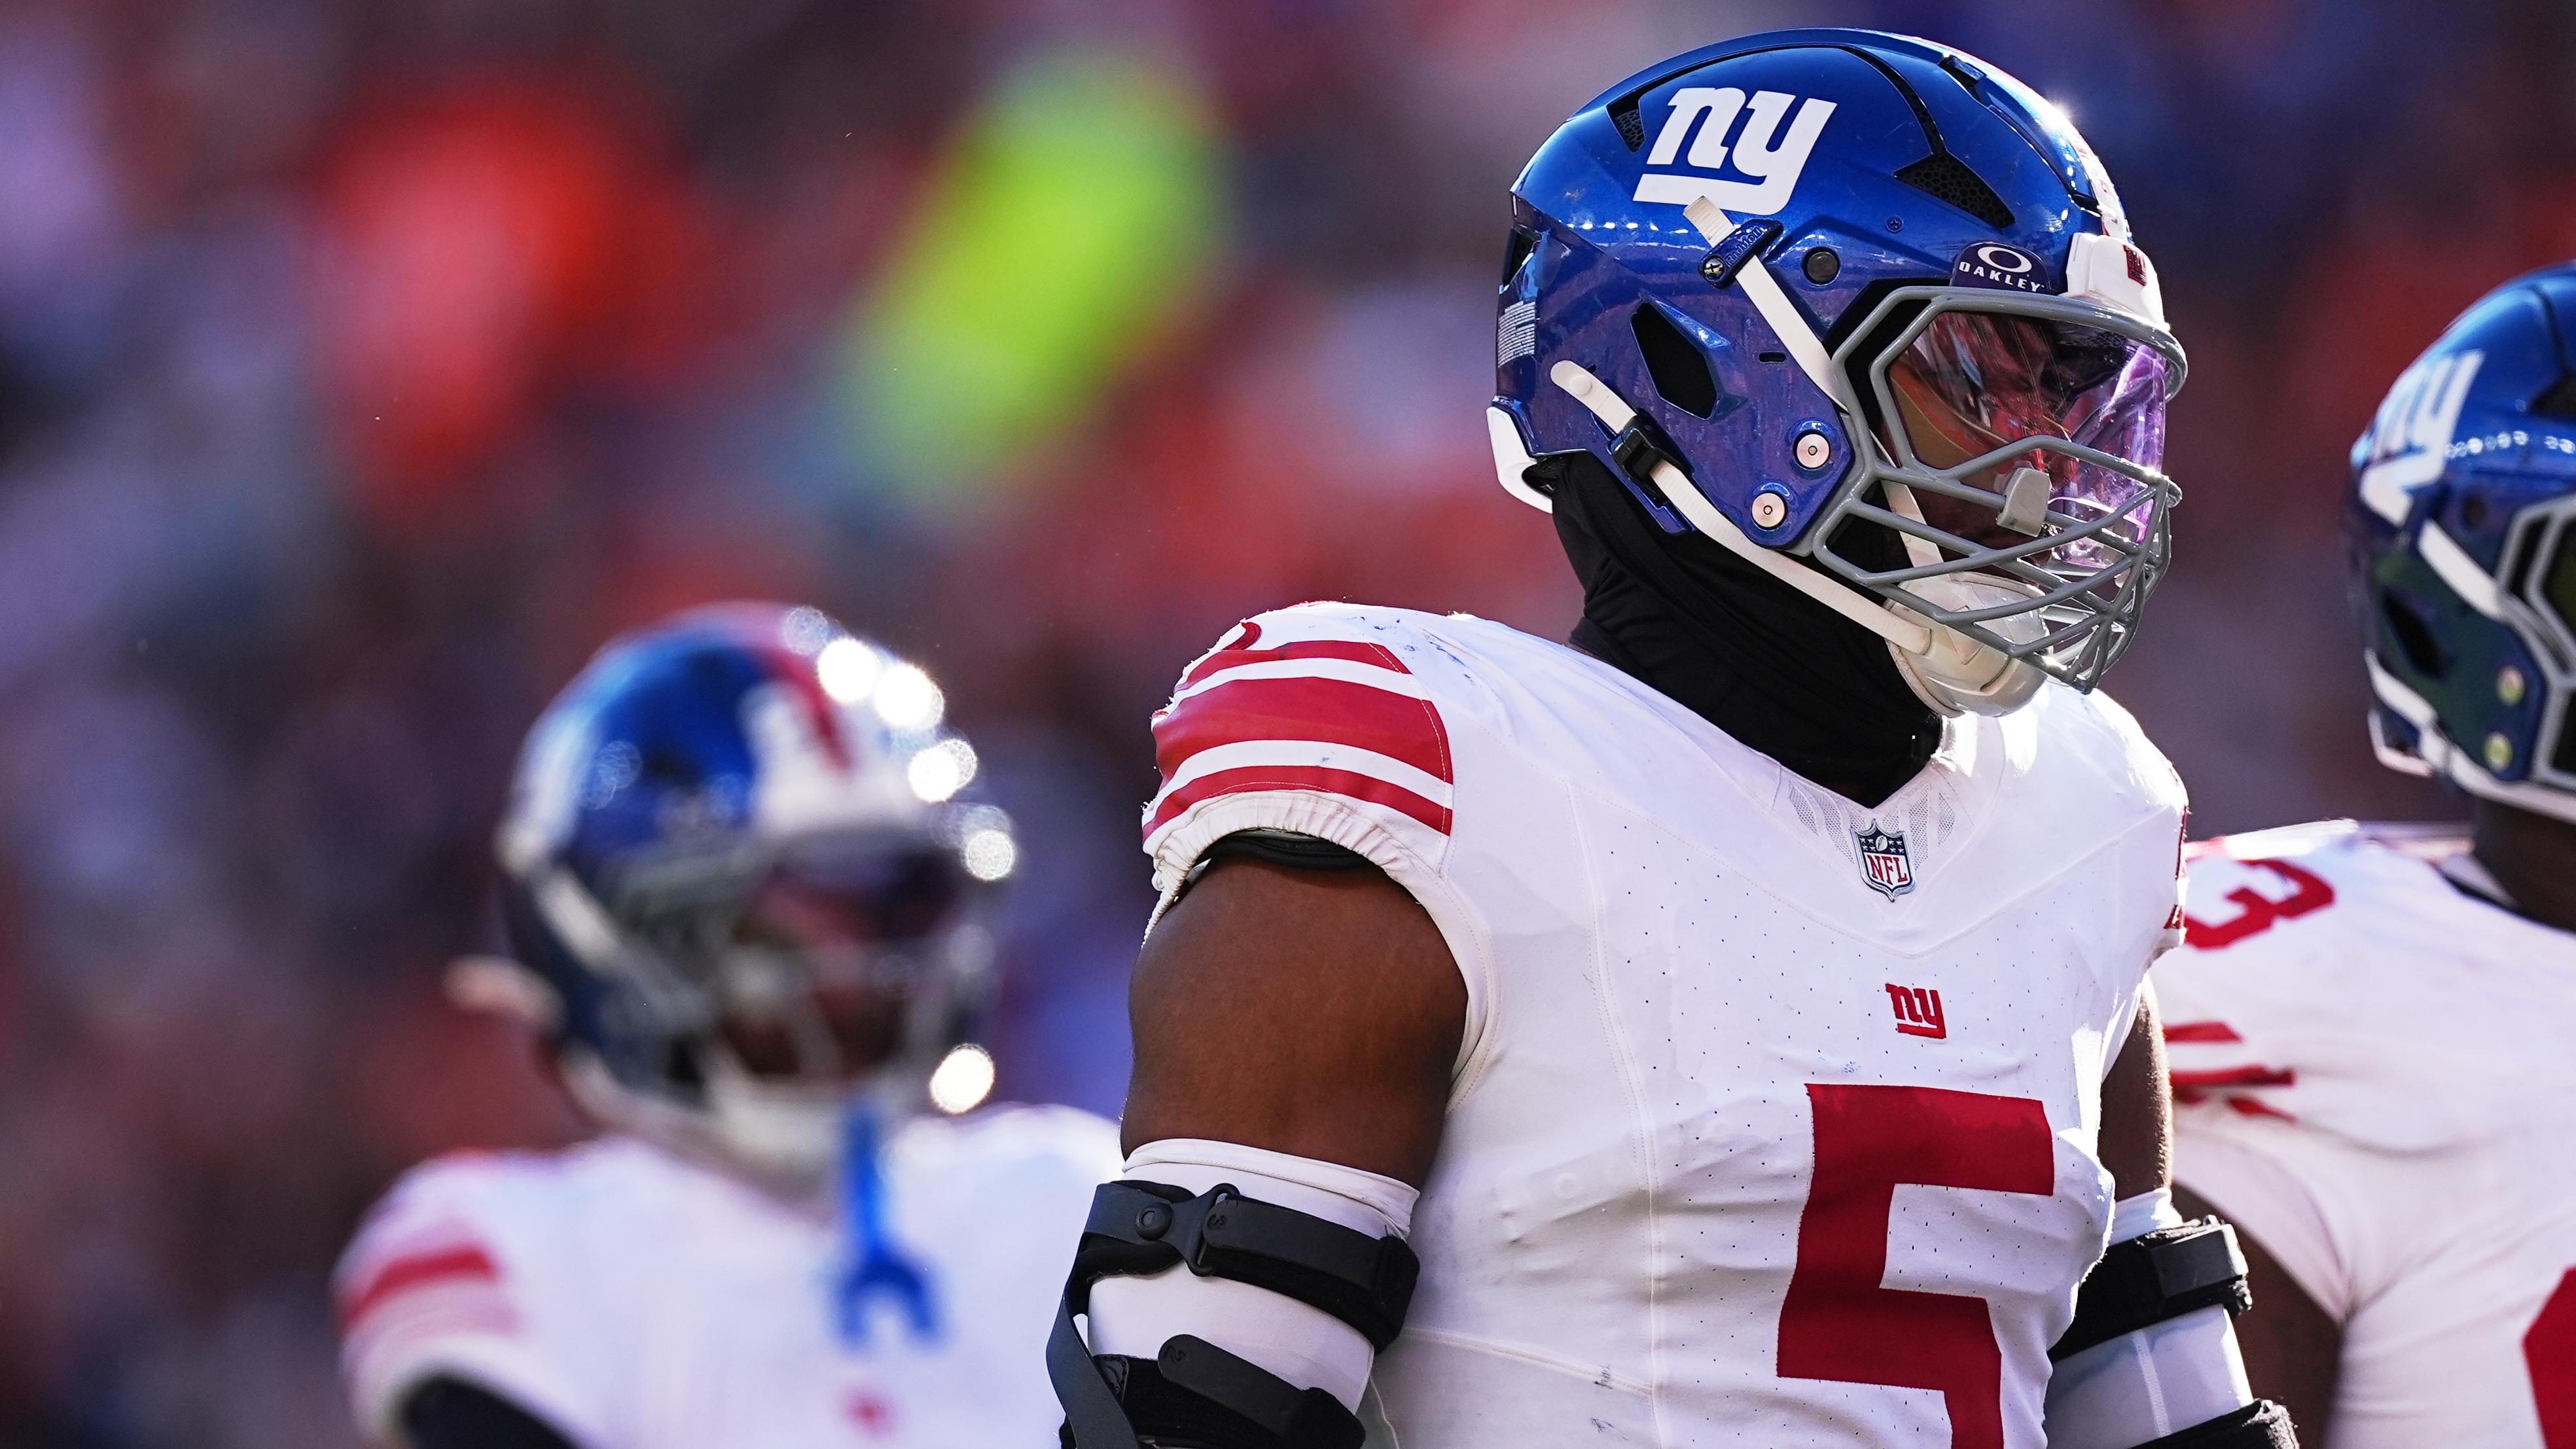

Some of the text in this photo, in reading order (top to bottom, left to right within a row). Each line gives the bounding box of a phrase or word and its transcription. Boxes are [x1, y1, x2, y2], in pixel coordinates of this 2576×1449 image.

[1633, 87, 1837, 215] ny
[1959, 261, 2041, 293] OAKLEY
[1867, 854, 1908, 885] NFL
[1885, 983, 1946, 1039] ny
[1776, 1083, 2055, 1449] 5
